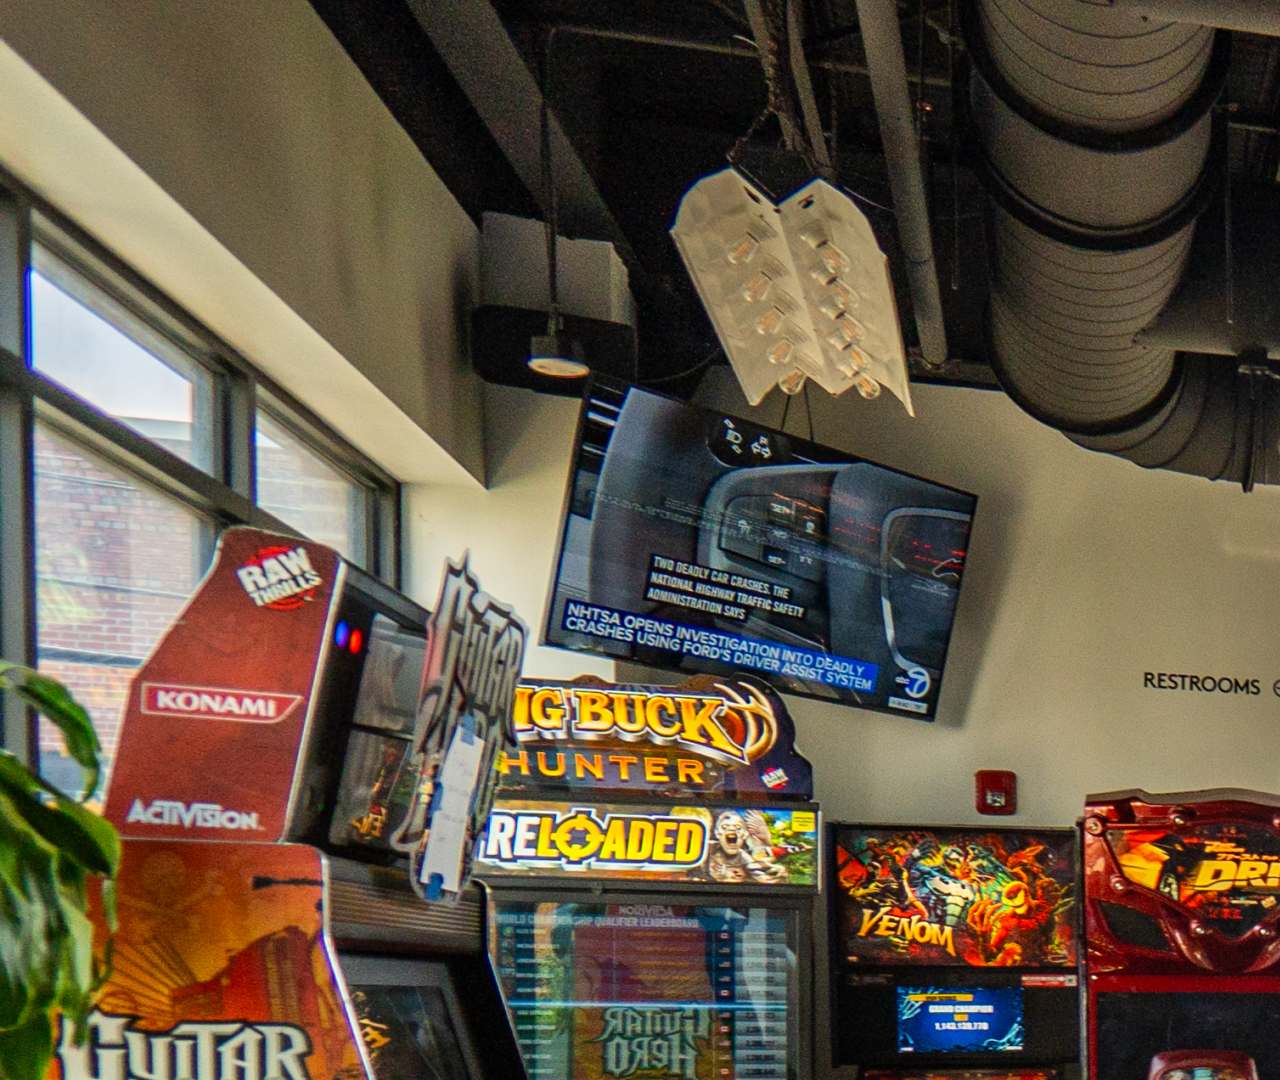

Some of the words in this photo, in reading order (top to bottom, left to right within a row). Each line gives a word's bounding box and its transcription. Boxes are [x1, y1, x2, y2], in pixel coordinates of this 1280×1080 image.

[237, 548, 311, 592] RAW
[654, 556, 674, 570] TWO
[676, 560, 710, 579] DEADLY
[711, 570, 729, 585] CAR
[772, 585, 791, 599] THE
[646, 587, 722, 614] ADMINISTRATION
[723, 605, 746, 620] SAYS
[650, 572, 694, 592] NATIONAL
[695, 582, 736, 601] HIGHWAY
[737, 592, 772, 610] TRAFFIC
[773, 601, 805, 618] SAFETY
[566, 616, 634, 642] CRASHES
[637, 633, 681, 651] USING
[683, 641, 732, 662] FORD'S
[733, 652, 784, 672] DRIVER
[781, 663, 822, 681] ASSIST
[825, 671, 873, 690] SYSTEM
[567, 603, 621, 626] NHTSA
[624, 616, 674, 636] OPENS
[677, 626, 781, 659] INVESTIGATION
[782, 649, 814, 666] INTO
[815, 656, 865, 677] DEADLY
[156, 690, 277, 718] KONAMI
[905, 667, 931, 698] 7
[1143, 672, 1262, 695] RESTROOMS
[514, 686, 567, 737] IG
[574, 688, 745, 760] BUCK
[500, 750, 706, 784] HUNTER
[127, 799, 259, 831] ACTIVISION
[486, 813, 706, 862] RELOADED
[857, 907, 957, 957] VENOM
